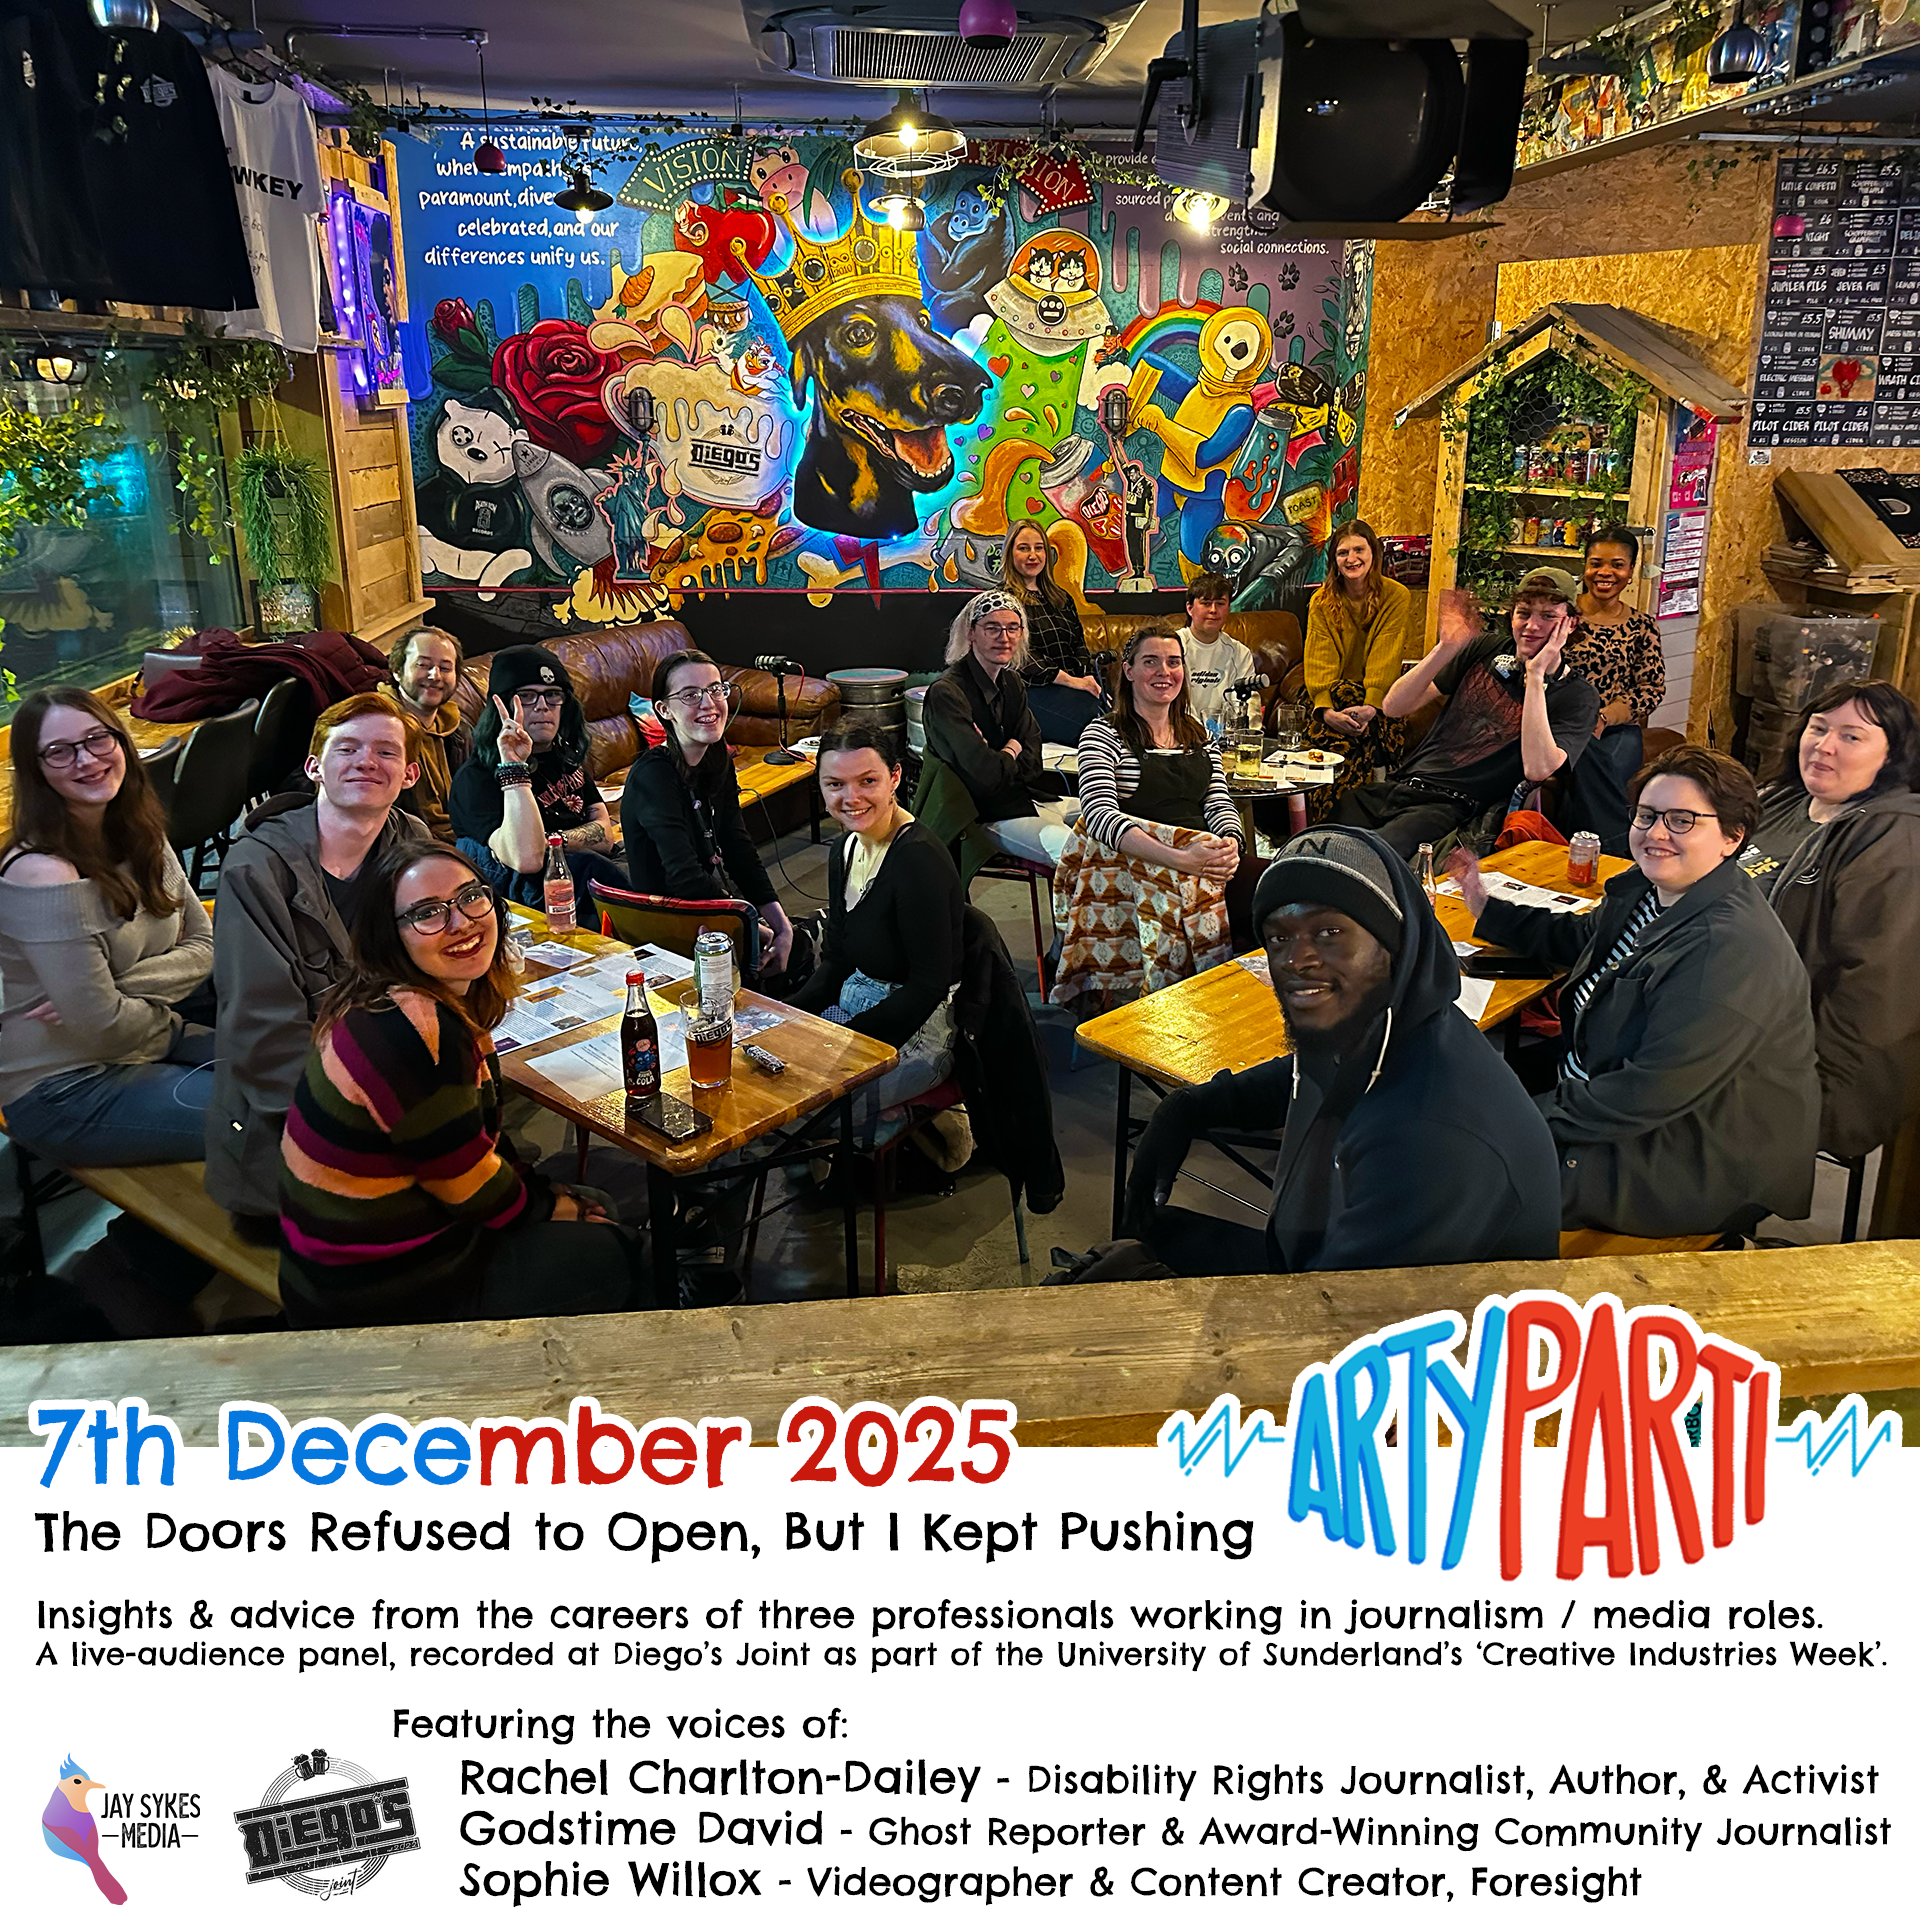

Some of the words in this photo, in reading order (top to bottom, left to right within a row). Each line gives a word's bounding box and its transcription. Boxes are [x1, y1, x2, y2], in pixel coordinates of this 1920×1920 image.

[461, 131, 476, 152] A
[480, 131, 578, 152] sustainable
[1105, 149, 1148, 167] provide
[643, 147, 741, 194] VISION
[1115, 191, 1161, 206] sourced
[1818, 213, 1832, 226] £6
[457, 217, 552, 239] celebrated,
[553, 218, 585, 237] and
[590, 220, 619, 237] our
[1805, 231, 1830, 243] NIGHT
[1220, 239, 1253, 255] social
[1256, 241, 1330, 255] connections.
[424, 246, 525, 265] differences
[530, 246, 575, 268] unify
[580, 250, 606, 266] us.
[1812, 264, 1826, 276] £3
[1872, 264, 1886, 276] £3
[1771, 280, 1805, 293] JUPILER
[1806, 280, 1828, 292] PILS
[1836, 281, 1862, 292] JEVER
[1865, 281, 1881, 292] FUN
[1828, 326, 1875, 341] SHIMMY
[1878, 374, 1907, 386] WRATH
[1856, 406, 1868, 417] £6
[1752, 420, 1779, 432] PILOT
[1782, 420, 1810, 432] CIDER
[1814, 421, 1840, 432] PILOT
[1842, 421, 1869, 432] CIDER
[1287, 496, 1317, 515] TOAST
[636, 1075, 655, 1086] COLA
